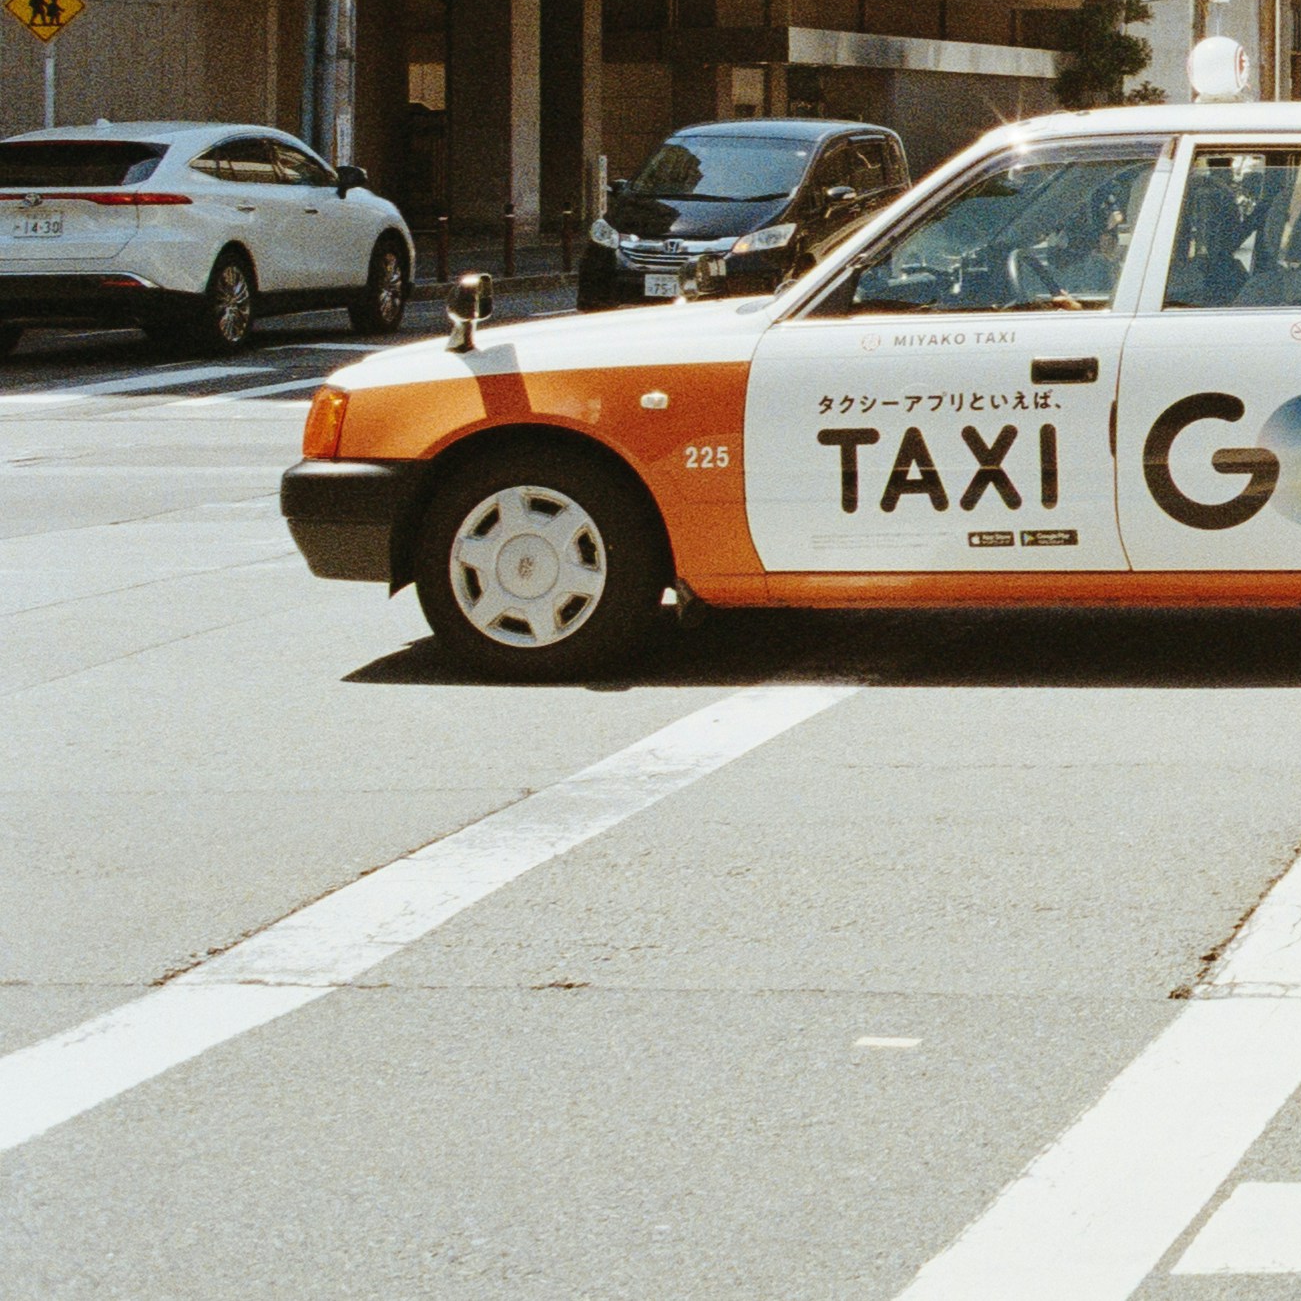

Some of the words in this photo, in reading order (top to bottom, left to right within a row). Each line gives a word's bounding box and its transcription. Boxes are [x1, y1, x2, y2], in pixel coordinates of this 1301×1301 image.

[894, 333, 966, 346] MIYAKO
[974, 331, 1016, 344] TAXI
[818, 391, 1062, 415] タクシーアプリといえば、
[685, 446, 730, 468] 225
[817, 423, 1059, 514] TAXI
